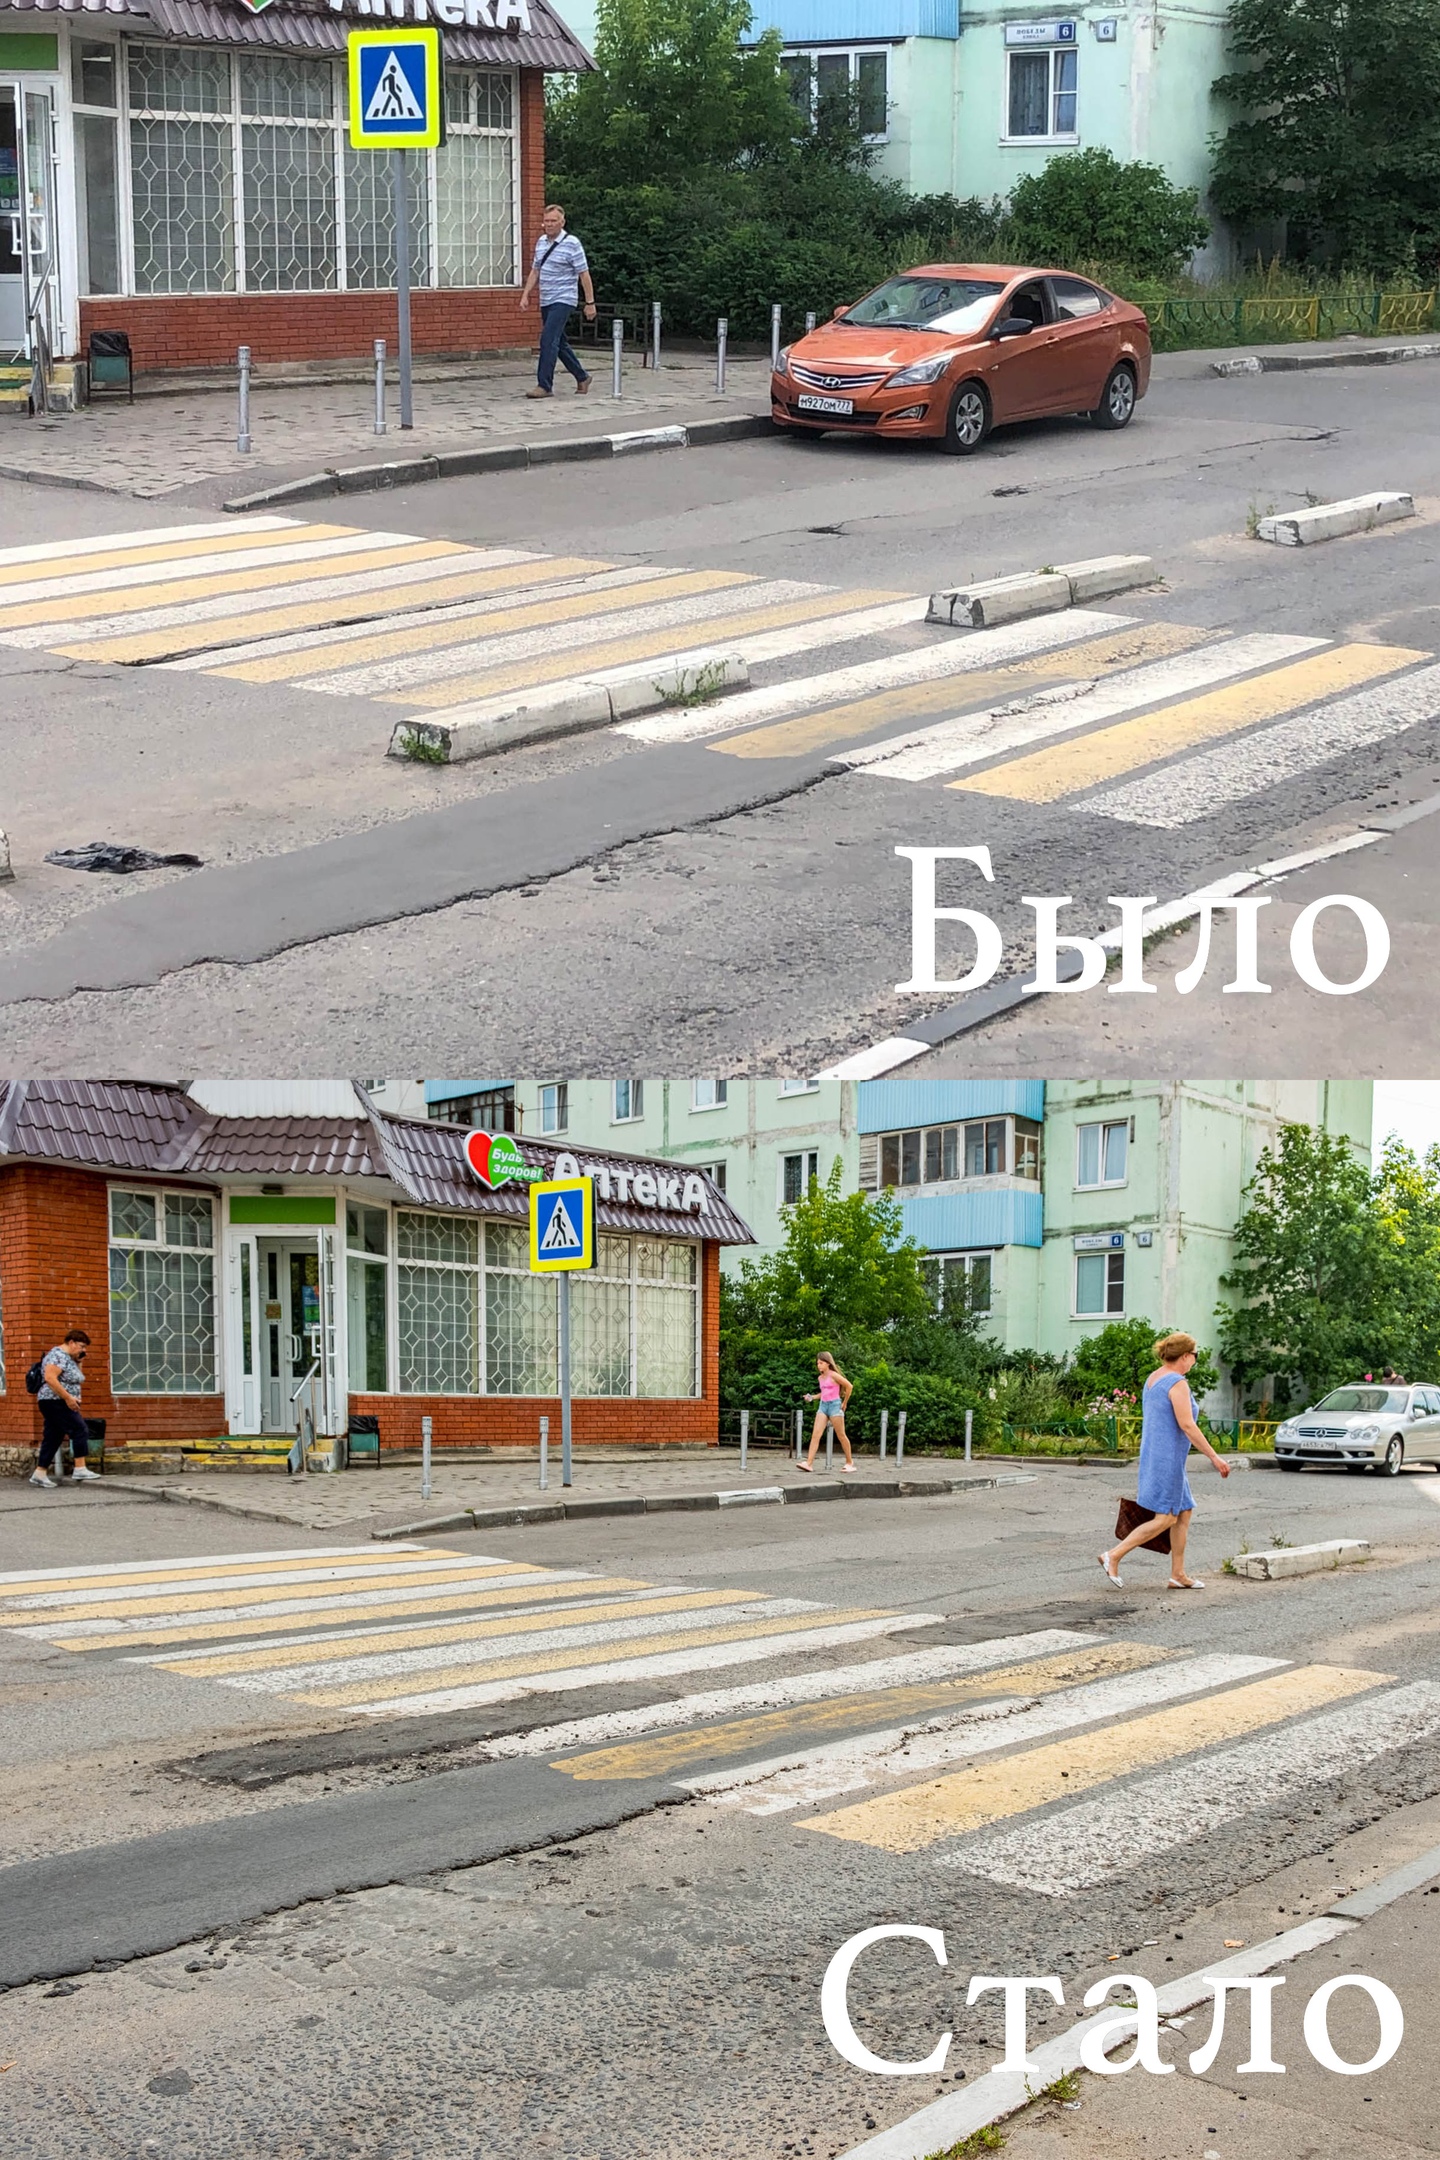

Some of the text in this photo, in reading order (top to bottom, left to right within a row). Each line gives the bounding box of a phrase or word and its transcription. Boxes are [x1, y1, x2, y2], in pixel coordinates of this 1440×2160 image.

[1062, 26, 1070, 37] 6
[1103, 25, 1110, 35] 6
[492, 1147, 523, 1163] Будь
[493, 1163, 541, 1179] здоров!
